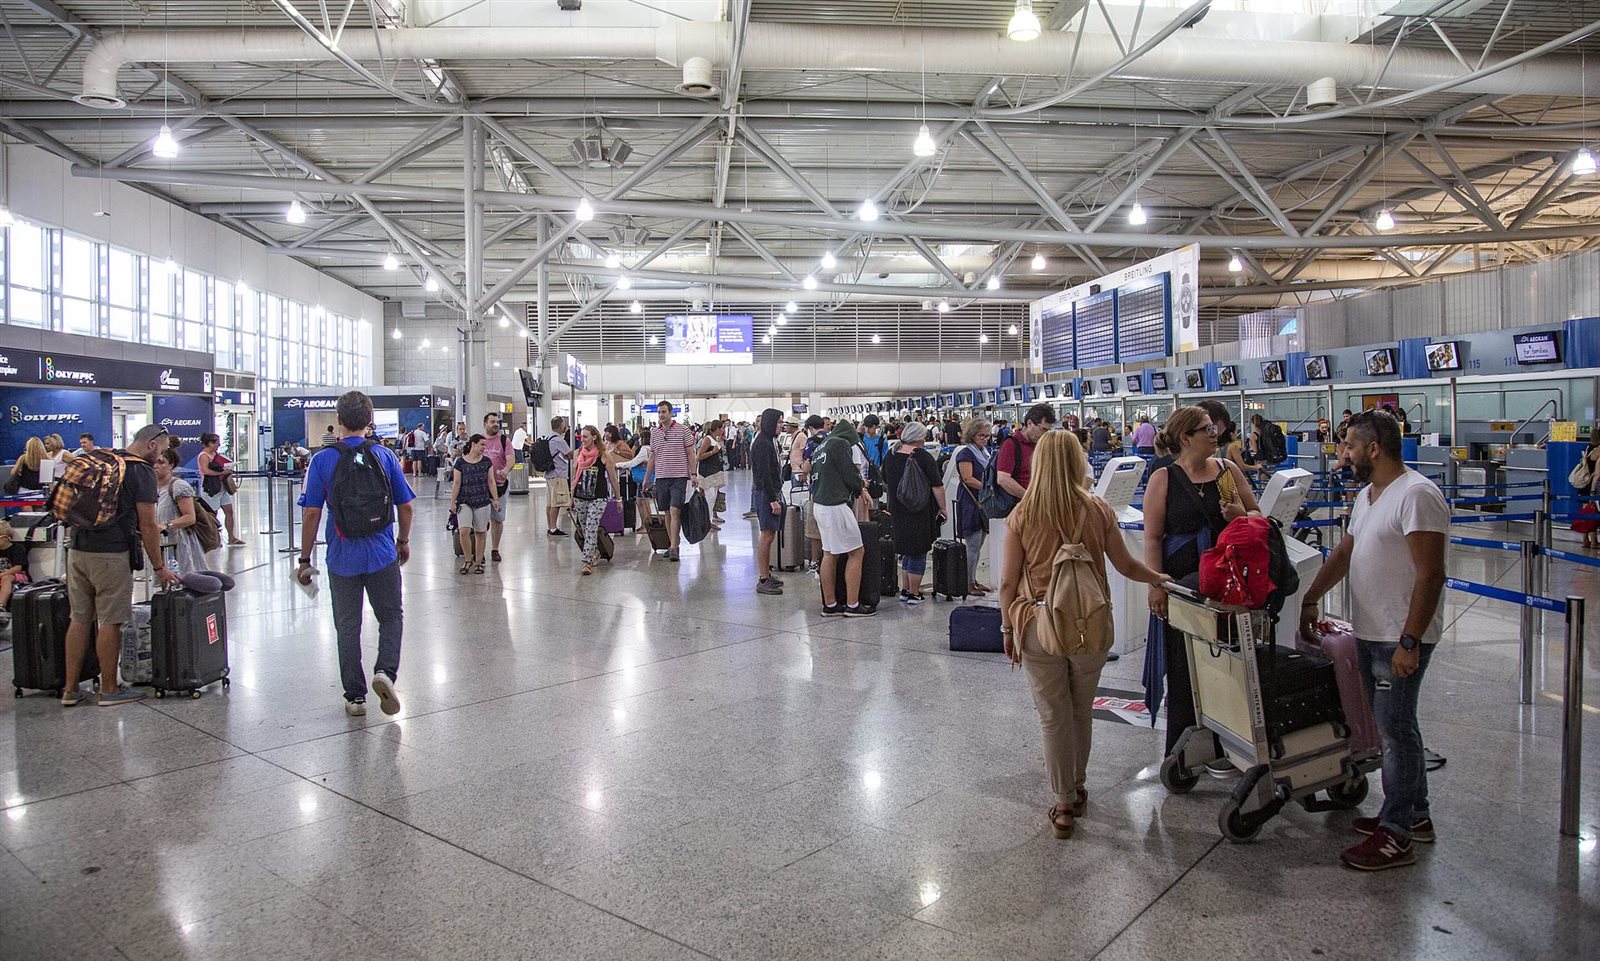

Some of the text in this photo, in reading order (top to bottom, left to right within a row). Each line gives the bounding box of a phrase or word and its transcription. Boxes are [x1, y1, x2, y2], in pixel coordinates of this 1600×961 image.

[1124, 264, 1152, 281] BREITLING
[1059, 289, 1080, 303] BREITLING
[1529, 335, 1549, 343] AEGEAN
[1468, 360, 1480, 370] 115
[1504, 357, 1516, 367] 114
[55, 370, 95, 381] OLYMPIC
[303, 400, 337, 408] AEGEAN
[23, 413, 80, 421] OLYMPIC
[1533, 597, 1553, 605] ATHENS
